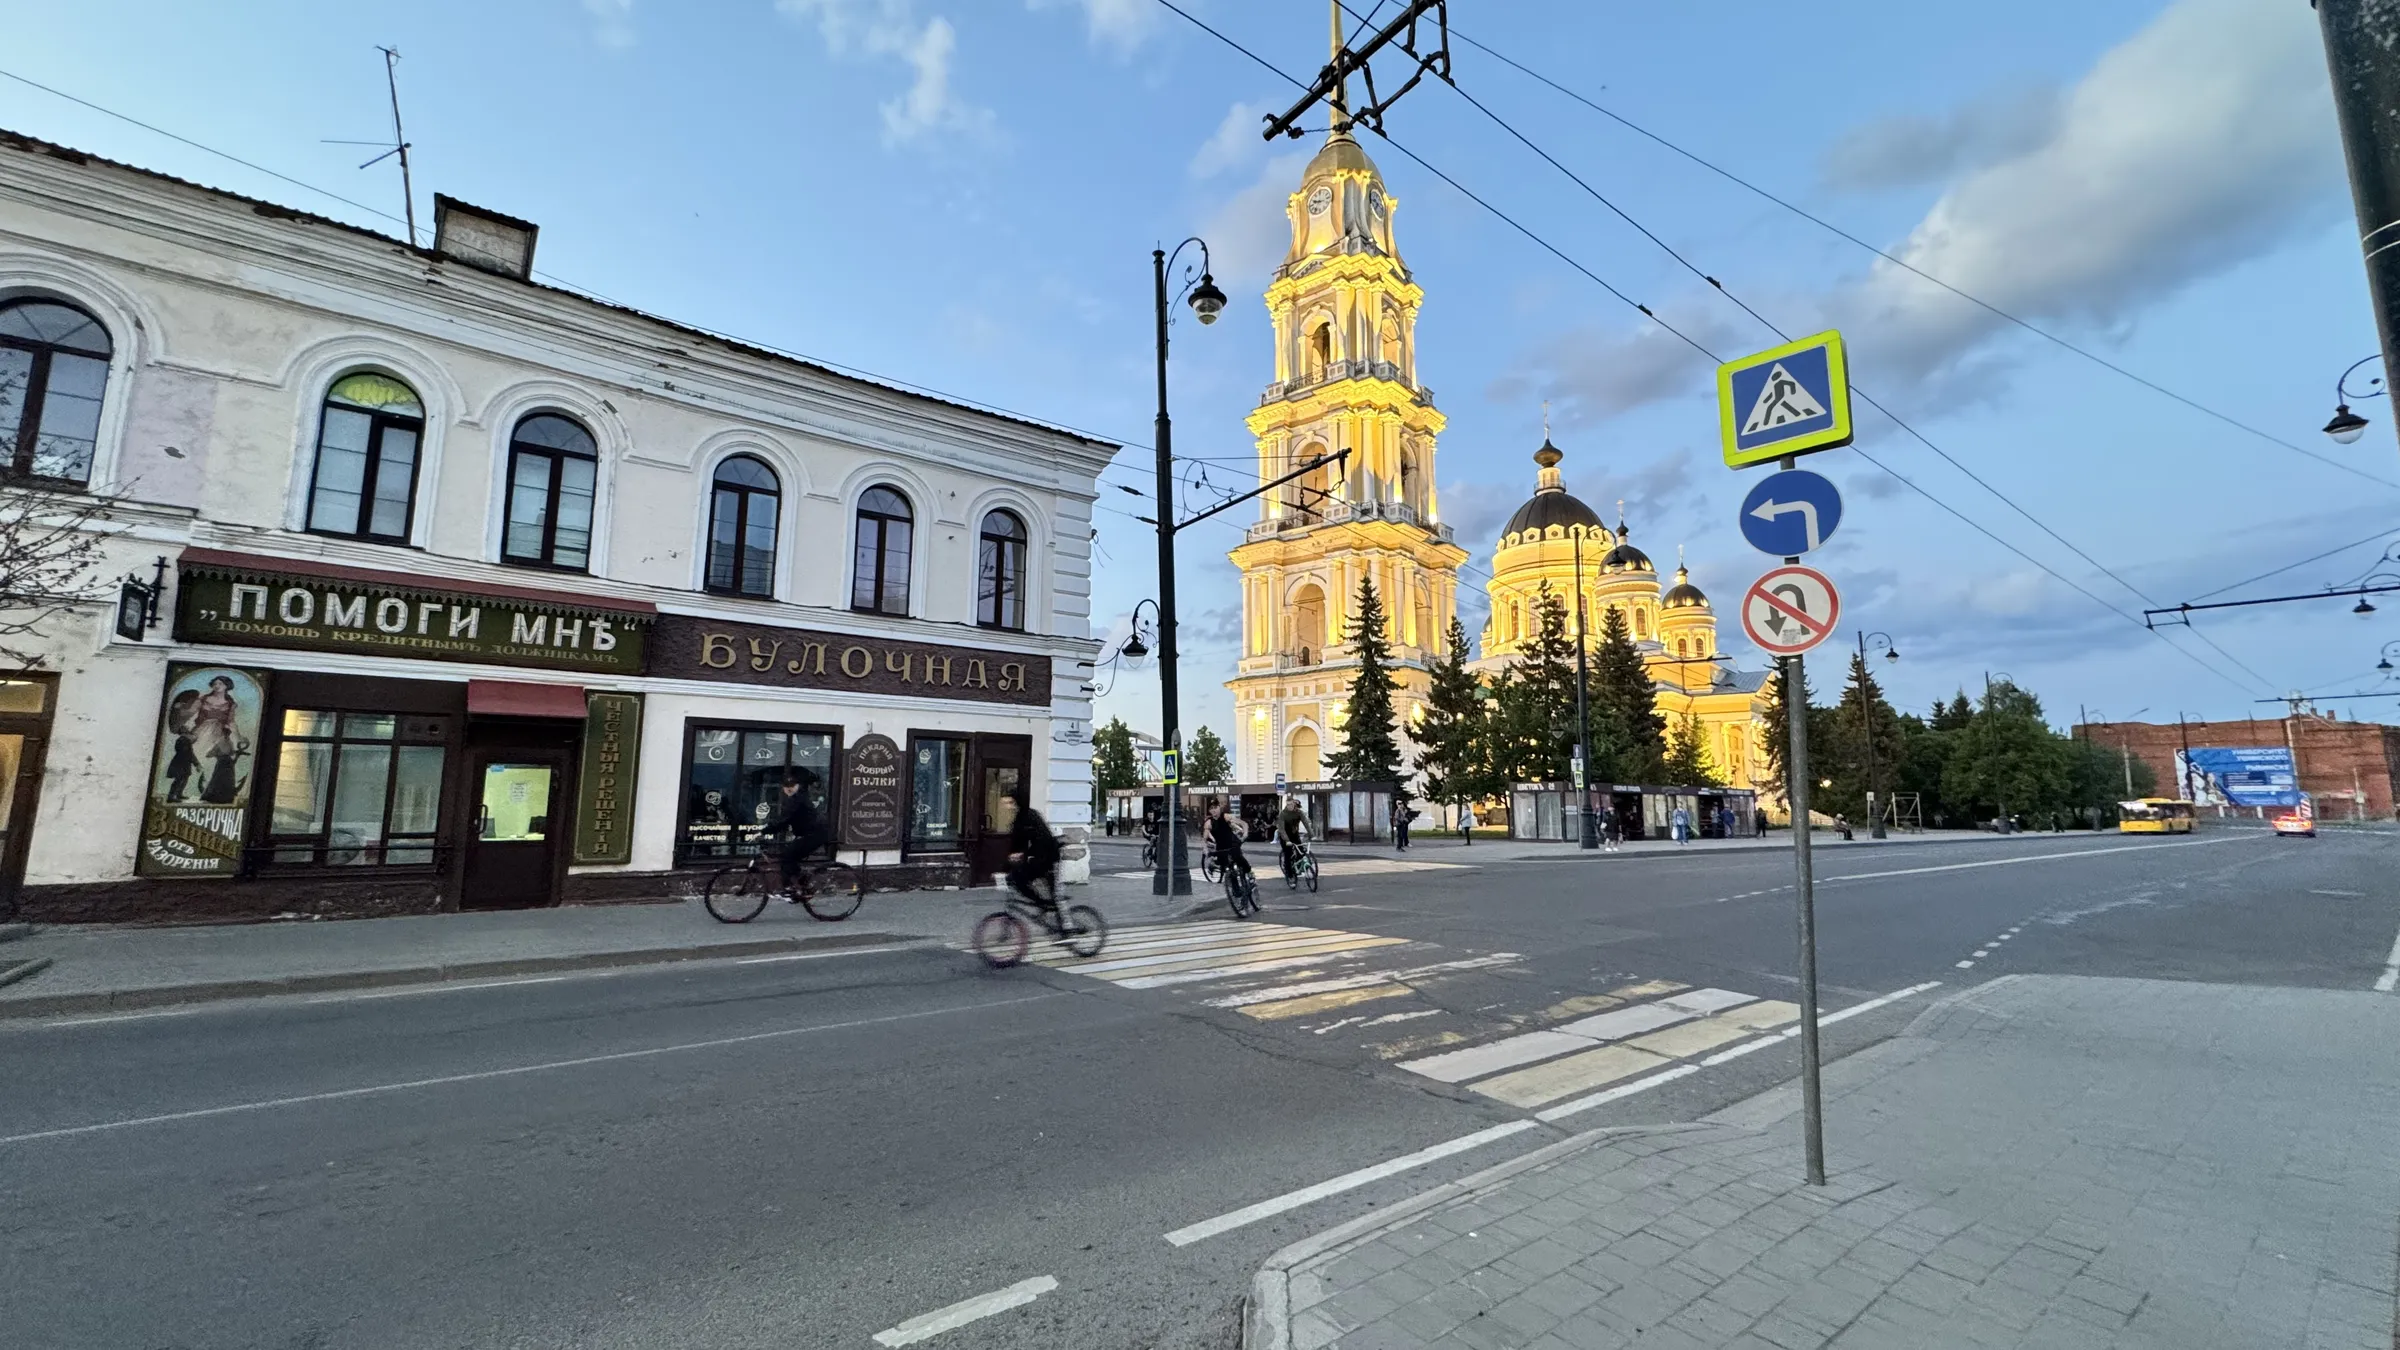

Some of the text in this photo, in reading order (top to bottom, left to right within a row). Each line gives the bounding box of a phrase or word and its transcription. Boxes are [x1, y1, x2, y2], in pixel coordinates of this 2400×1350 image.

[218, 620, 619, 664] ПОМОЩЬ КРЕДИТНЫМЪ ДОЛЖНИКАМЪ
[700, 632, 1027, 692] БУЛОЧНАЯ
[858, 743, 893, 760] ПЕКАРНЯ
[176, 807, 244, 841] РАЗСРОЧКА
